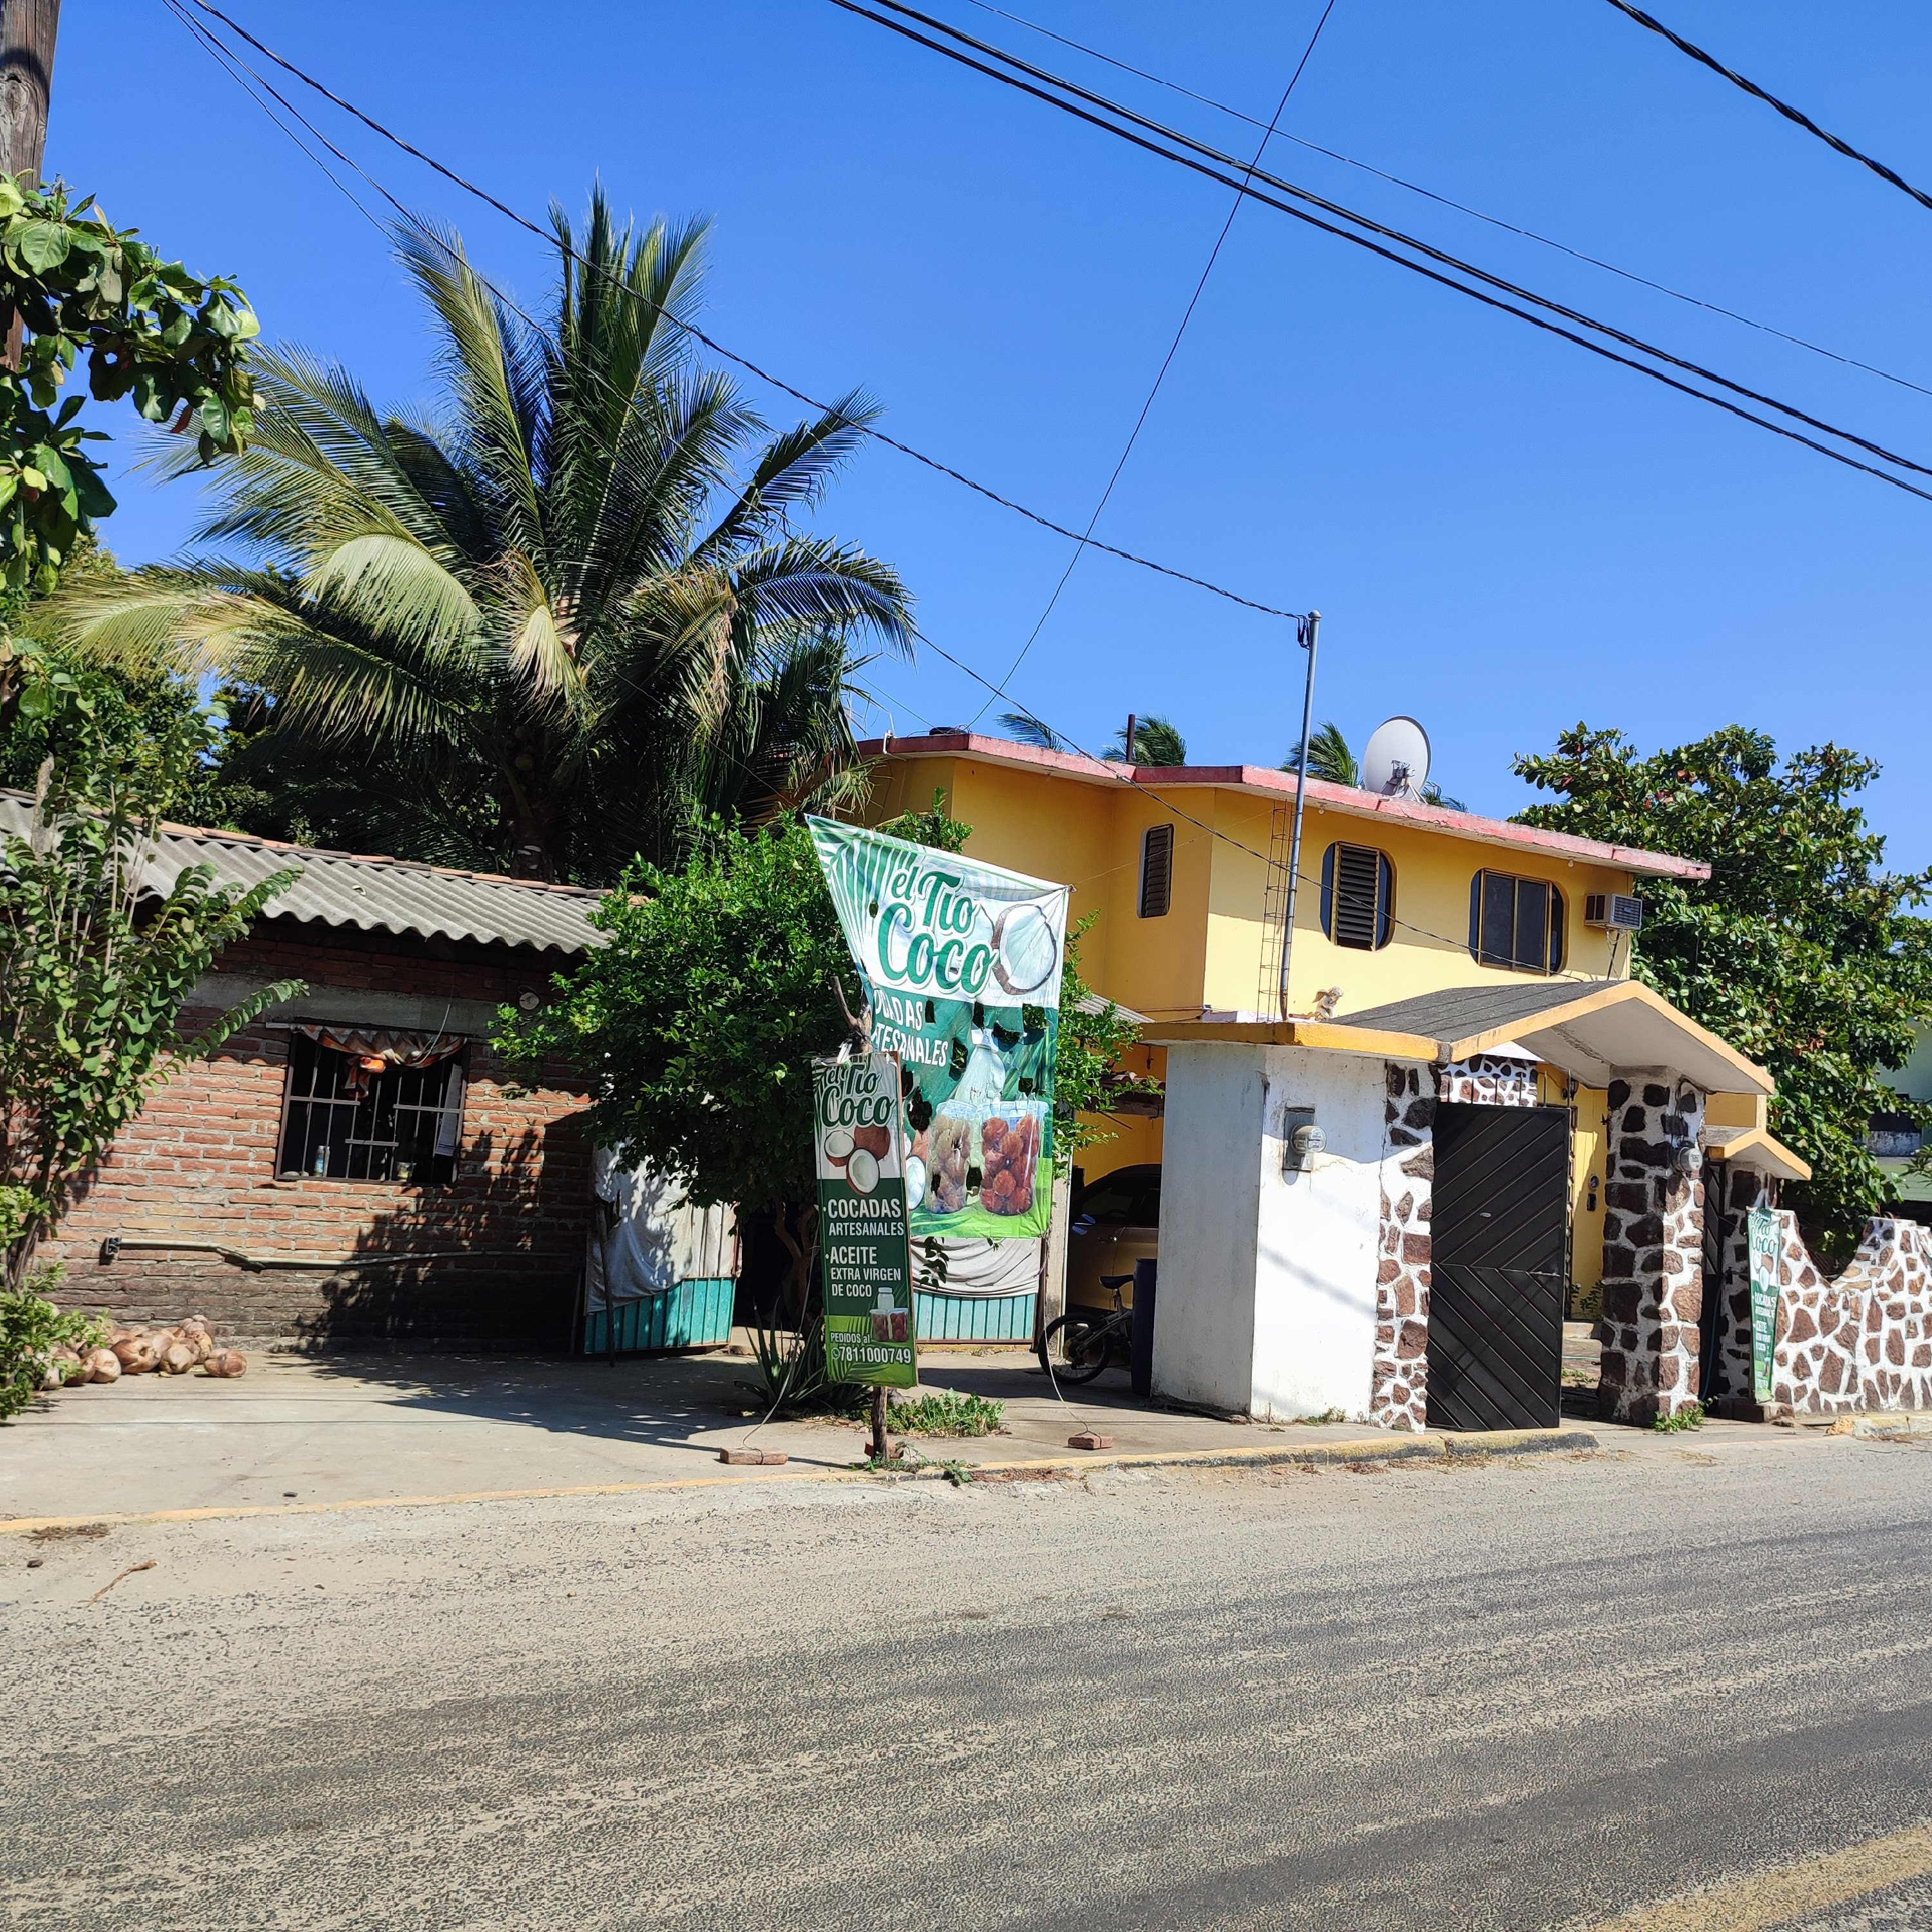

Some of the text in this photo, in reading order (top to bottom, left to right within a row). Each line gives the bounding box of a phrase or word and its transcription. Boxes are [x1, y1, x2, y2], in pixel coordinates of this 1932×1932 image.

[891, 866, 919, 900] el
[878, 904, 998, 994] Coco
[822, 1085, 895, 1127] Coco
[828, 1198, 902, 1218] COCADAS
[829, 1222, 904, 1236] ARTESANALES
[830, 1246, 877, 1264] ACEITE
[831, 1267, 901, 1281] EXTRA VIRGEN
[832, 1283, 872, 1297] DE COCO
[831, 1333, 870, 1343] PEDIDOS al
[839, 1346, 911, 1364] 7811000749
